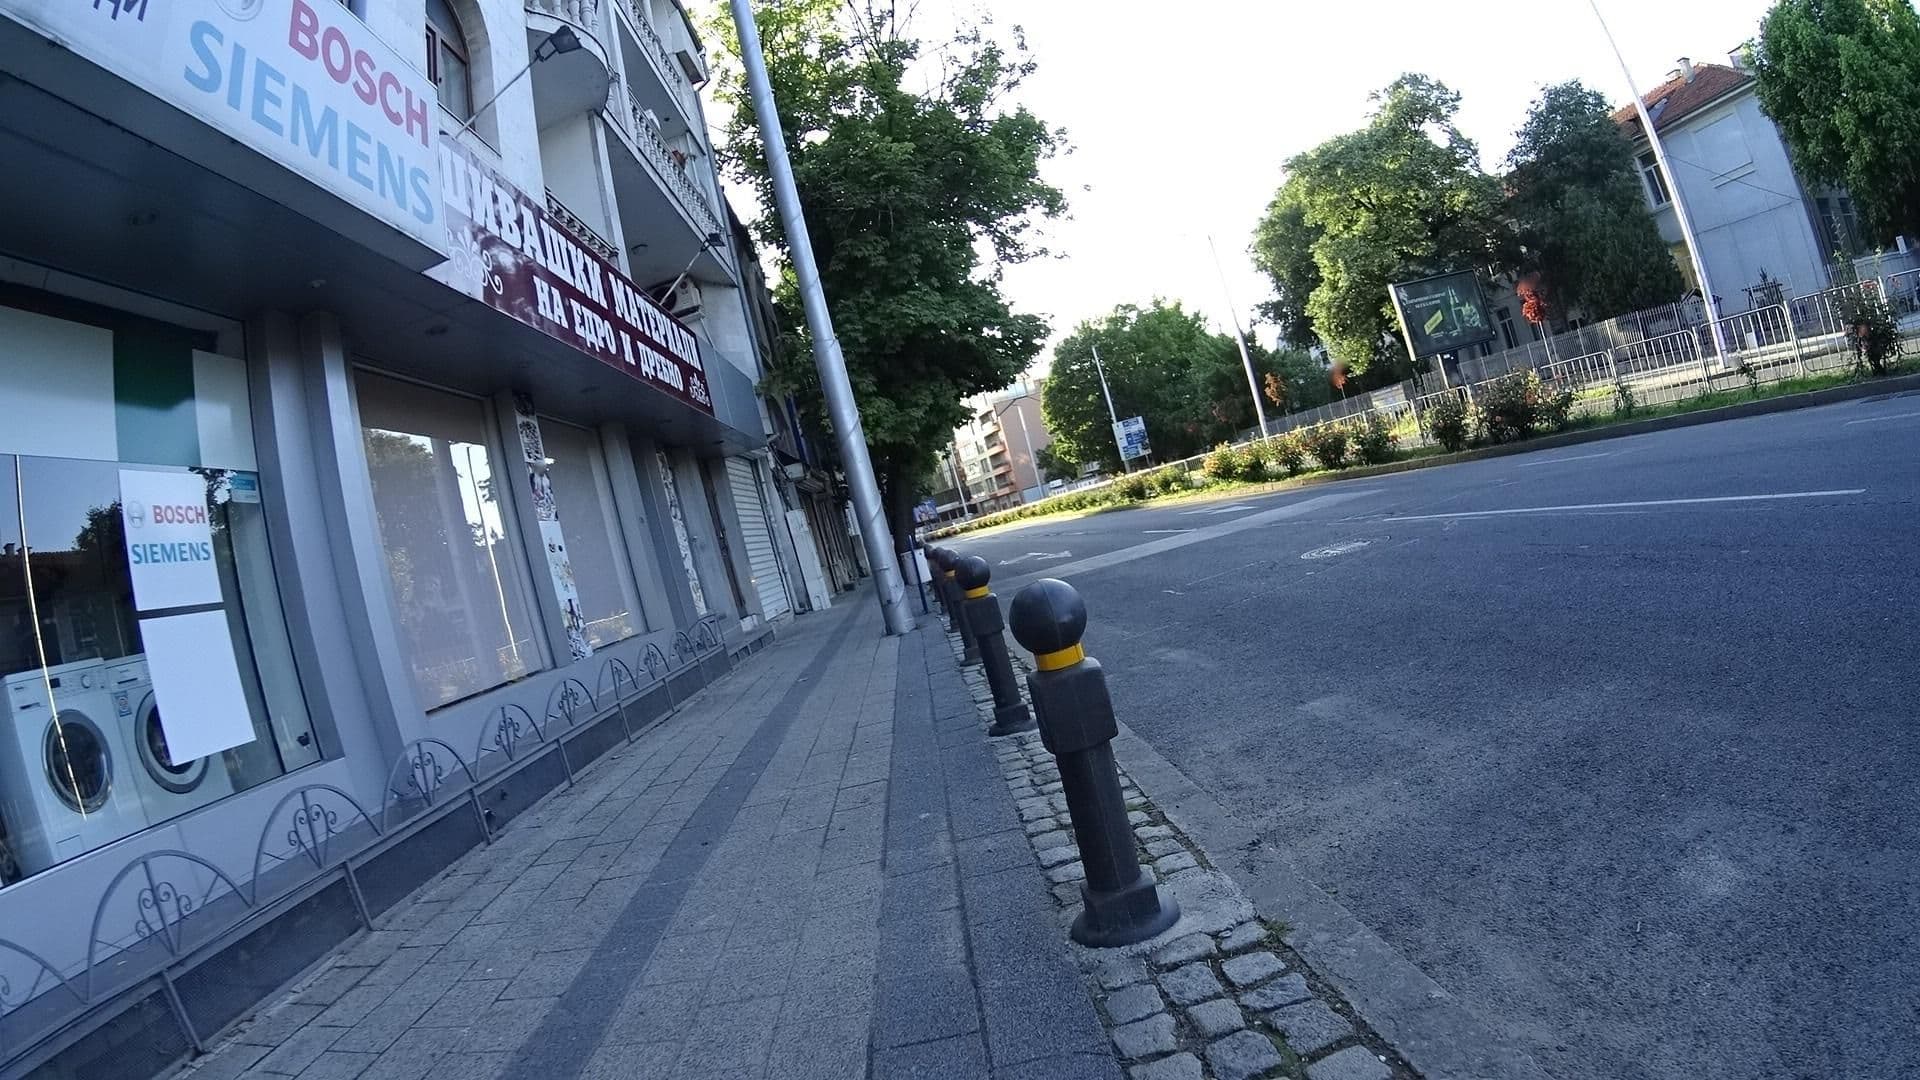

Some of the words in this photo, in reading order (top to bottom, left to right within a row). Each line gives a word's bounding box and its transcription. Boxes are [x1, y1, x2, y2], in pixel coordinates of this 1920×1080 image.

[184, 20, 434, 225] SIEMENS
[288, 0, 430, 148] BOSCH
[533, 274, 569, 329] НА
[569, 297, 617, 355] ЕДРО
[619, 330, 636, 366] И
[636, 338, 685, 392] ДРЕБНО
[608, 271, 703, 372] МАТЕРИАЛИ
[131, 541, 212, 565] SIEMENS
[152, 504, 207, 525] BOSCH
